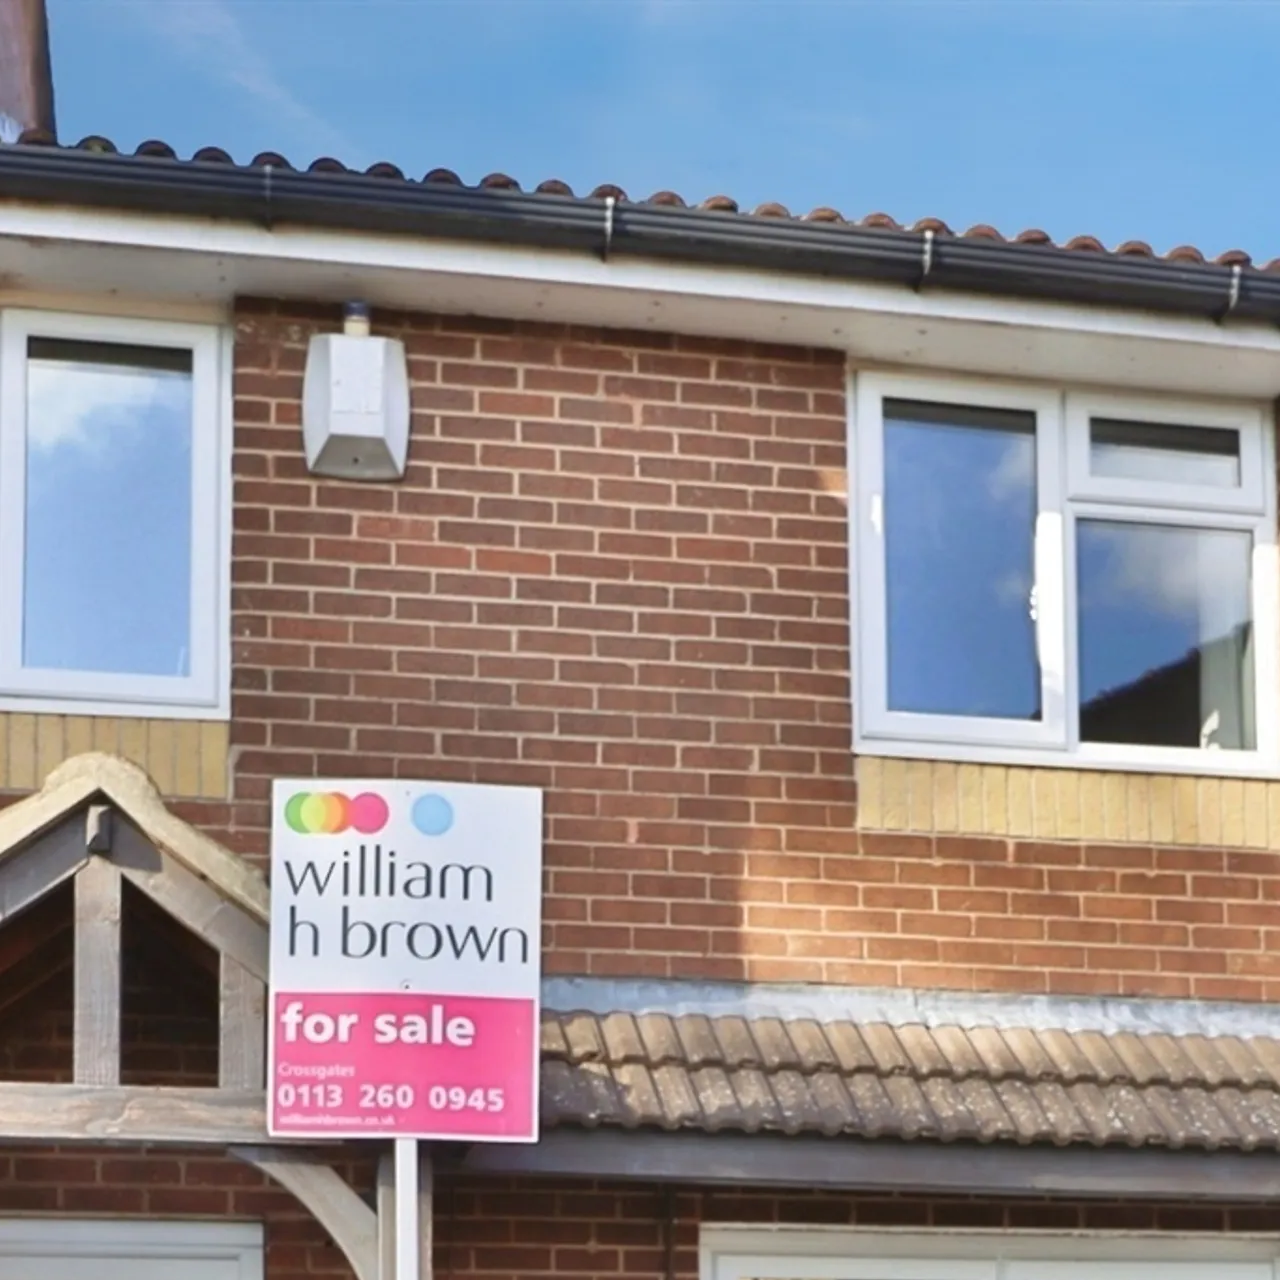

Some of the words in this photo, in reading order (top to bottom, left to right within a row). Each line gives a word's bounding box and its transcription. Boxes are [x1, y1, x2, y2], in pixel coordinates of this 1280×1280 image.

[283, 844, 494, 902] william
[288, 905, 320, 957] h
[341, 905, 529, 964] brown
[280, 1001, 359, 1044] for
[373, 1004, 476, 1047] sale
[277, 1083, 344, 1109] 0113
[358, 1084, 415, 1109] 260
[428, 1086, 505, 1113] 0945
